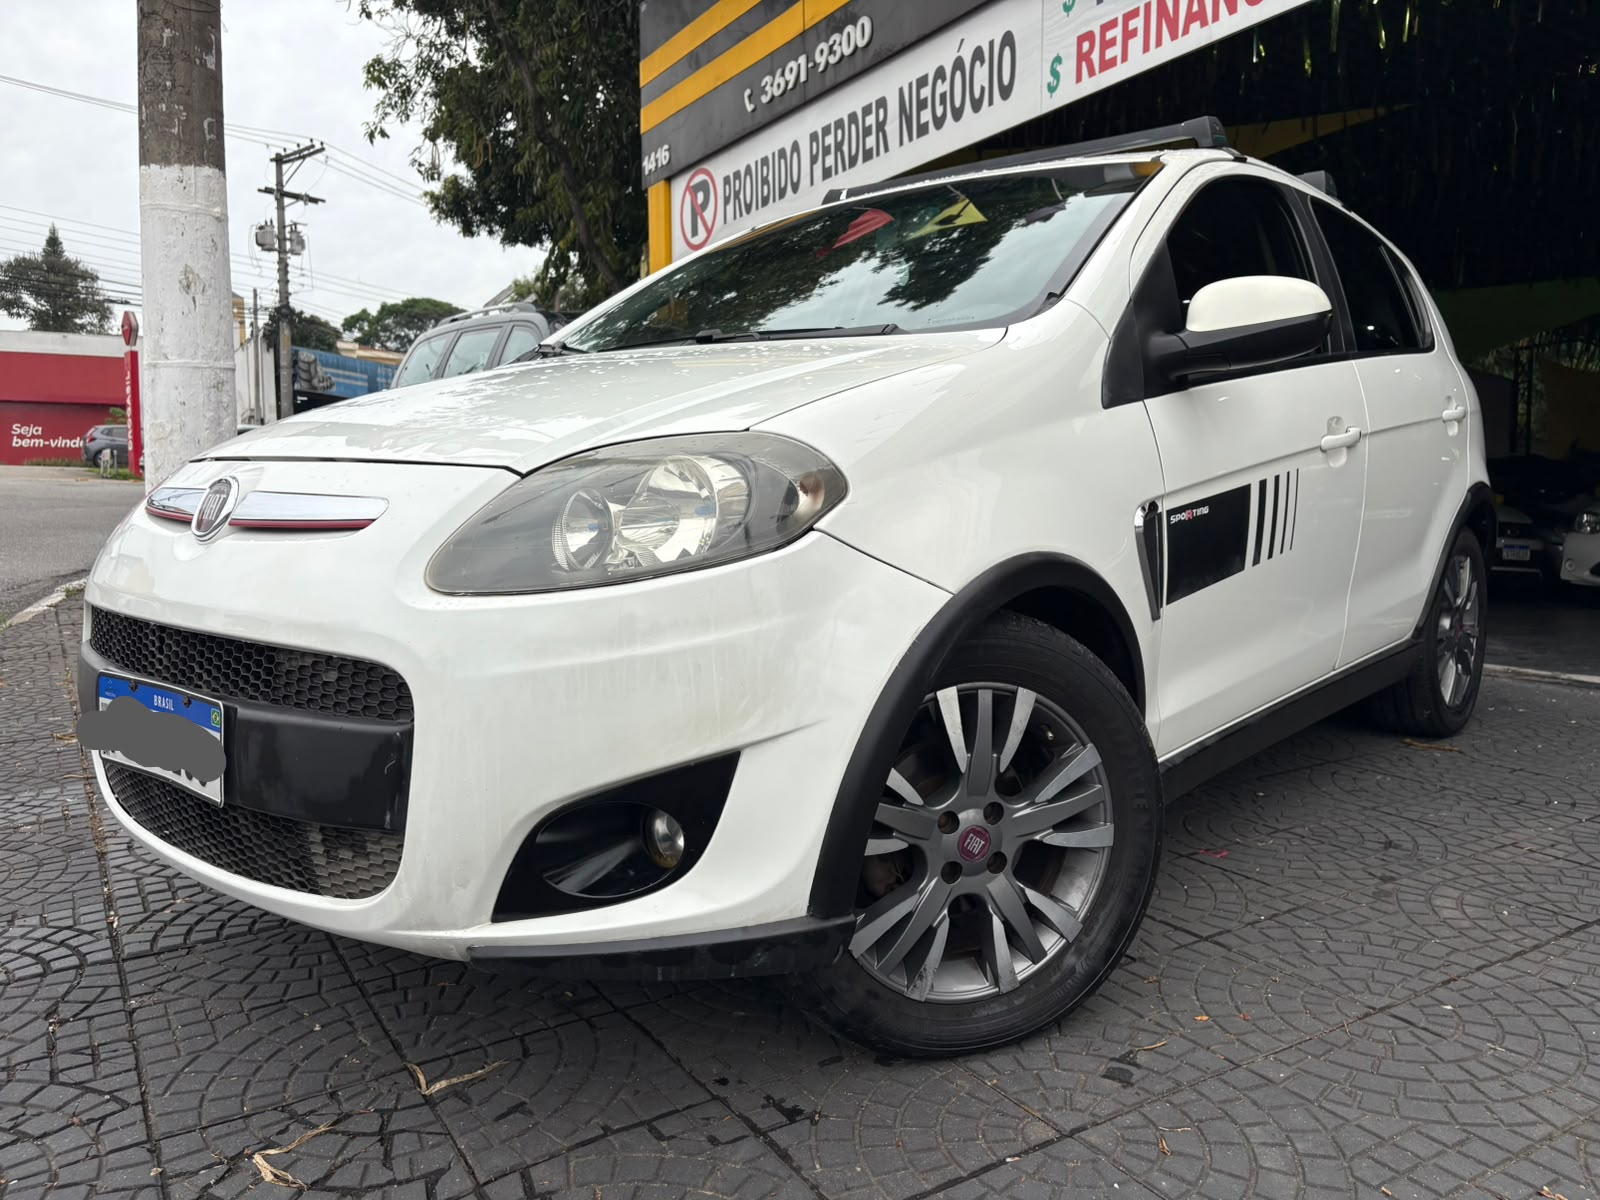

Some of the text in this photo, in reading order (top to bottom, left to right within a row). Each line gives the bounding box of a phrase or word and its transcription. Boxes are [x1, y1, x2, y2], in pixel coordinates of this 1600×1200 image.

[760, 15, 873, 104] 3691-9300
[722, 139, 800, 225] PROIBIDO
[809, 95, 890, 186] PERDER
[898, 30, 1017, 147] NEGÓCIO
[642, 144, 671, 176] 1416
[11, 423, 42, 437] Seja
[1170, 505, 1210, 525] SPORTING
[153, 694, 175, 711] BRASIL
[963, 833, 985, 855] FIAT
